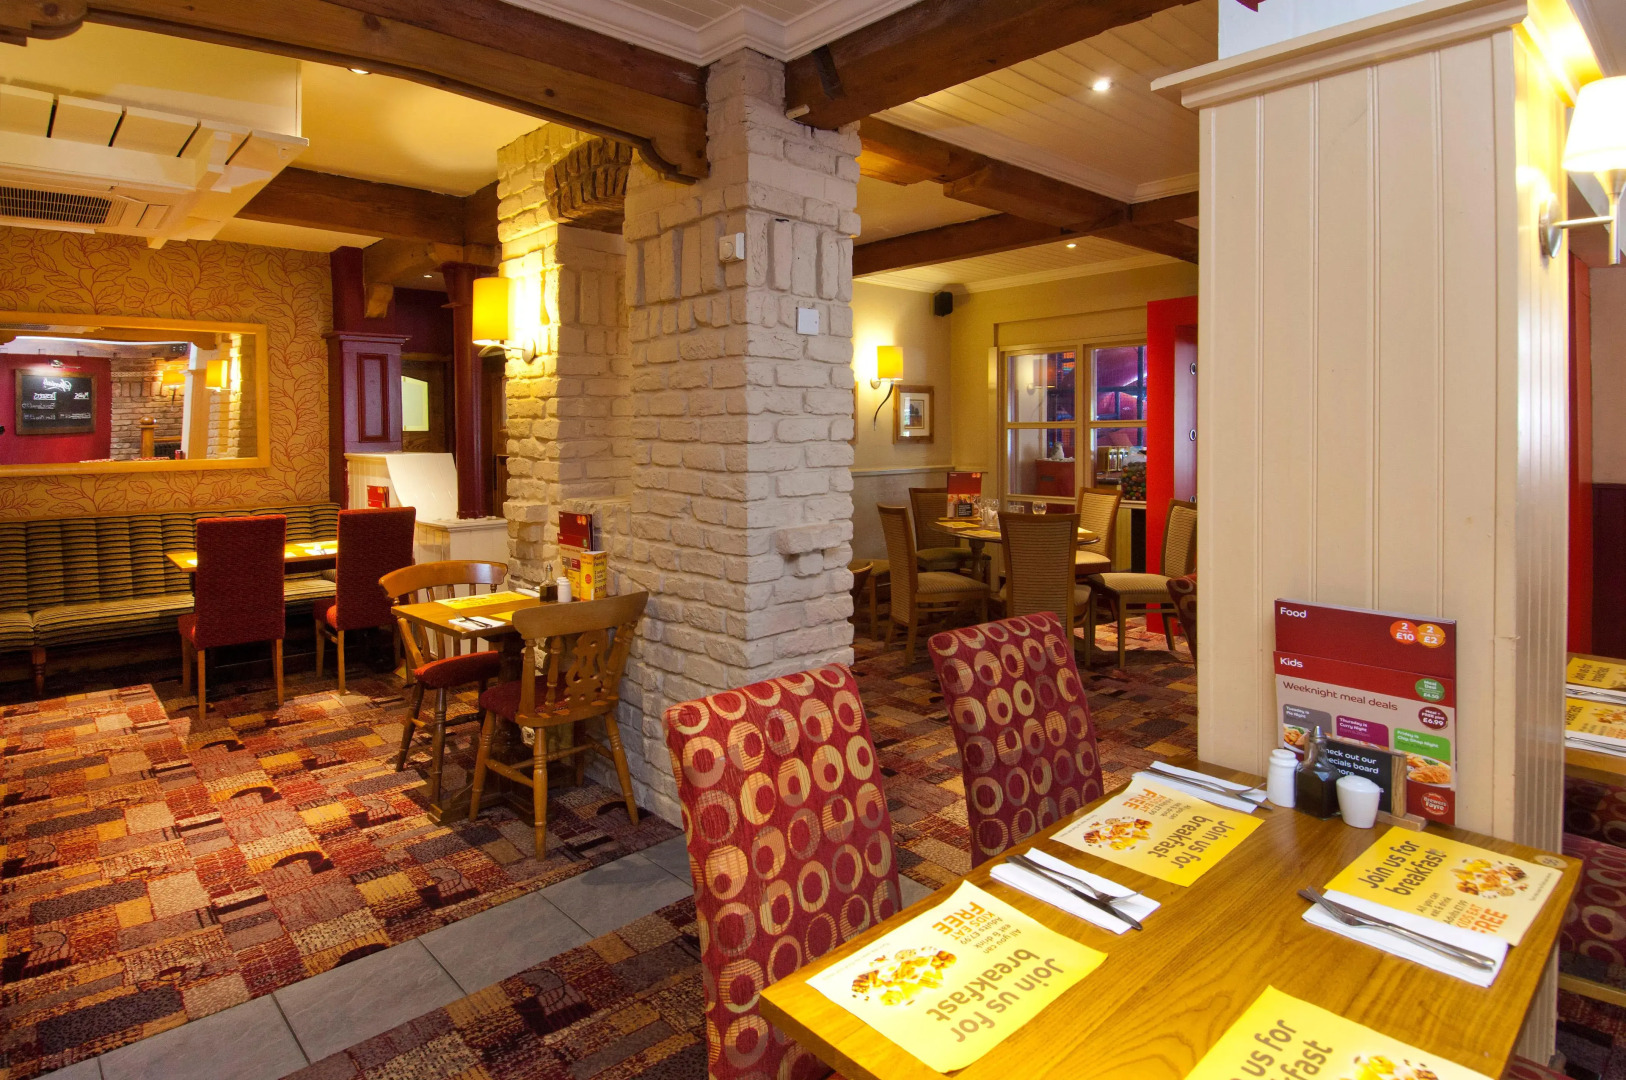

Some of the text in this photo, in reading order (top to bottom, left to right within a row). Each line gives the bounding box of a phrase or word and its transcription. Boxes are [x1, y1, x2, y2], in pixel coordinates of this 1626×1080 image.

[1280, 606, 1307, 619] Food
[1395, 632, 1415, 641] £10
[1401, 622, 1409, 630] 2
[1426, 625, 1434, 633] 2
[1423, 636, 1438, 644] £2
[1280, 657, 1304, 668] Kids
[1283, 681, 1398, 711] Weeknight meal deals
[1339, 718, 1363, 727] Thursday
[1339, 722, 1354, 730] Curry
[1423, 717, 1444, 726] £6.99
[1344, 753, 1359, 761] out
[1361, 756, 1377, 764] our
[1353, 762, 1379, 774] board
[1122, 788, 1157, 809] FREE
[1147, 815, 1214, 858] breakfast
[1170, 821, 1235, 869] Join us for
[1358, 840, 1420, 889] Join us for
[1384, 849, 1447, 896] breakfast
[932, 901, 985, 935] FREE
[950, 911, 995, 940] KIDS EAT
[960, 916, 1003, 945] Adults £7.99
[983, 928, 1021, 954] All you can
[973, 935, 993, 948] drink
[926, 949, 1041, 1021] breakfast
[950, 958, 1064, 1043] Join us for
[1241, 1019, 1297, 1077] us for
